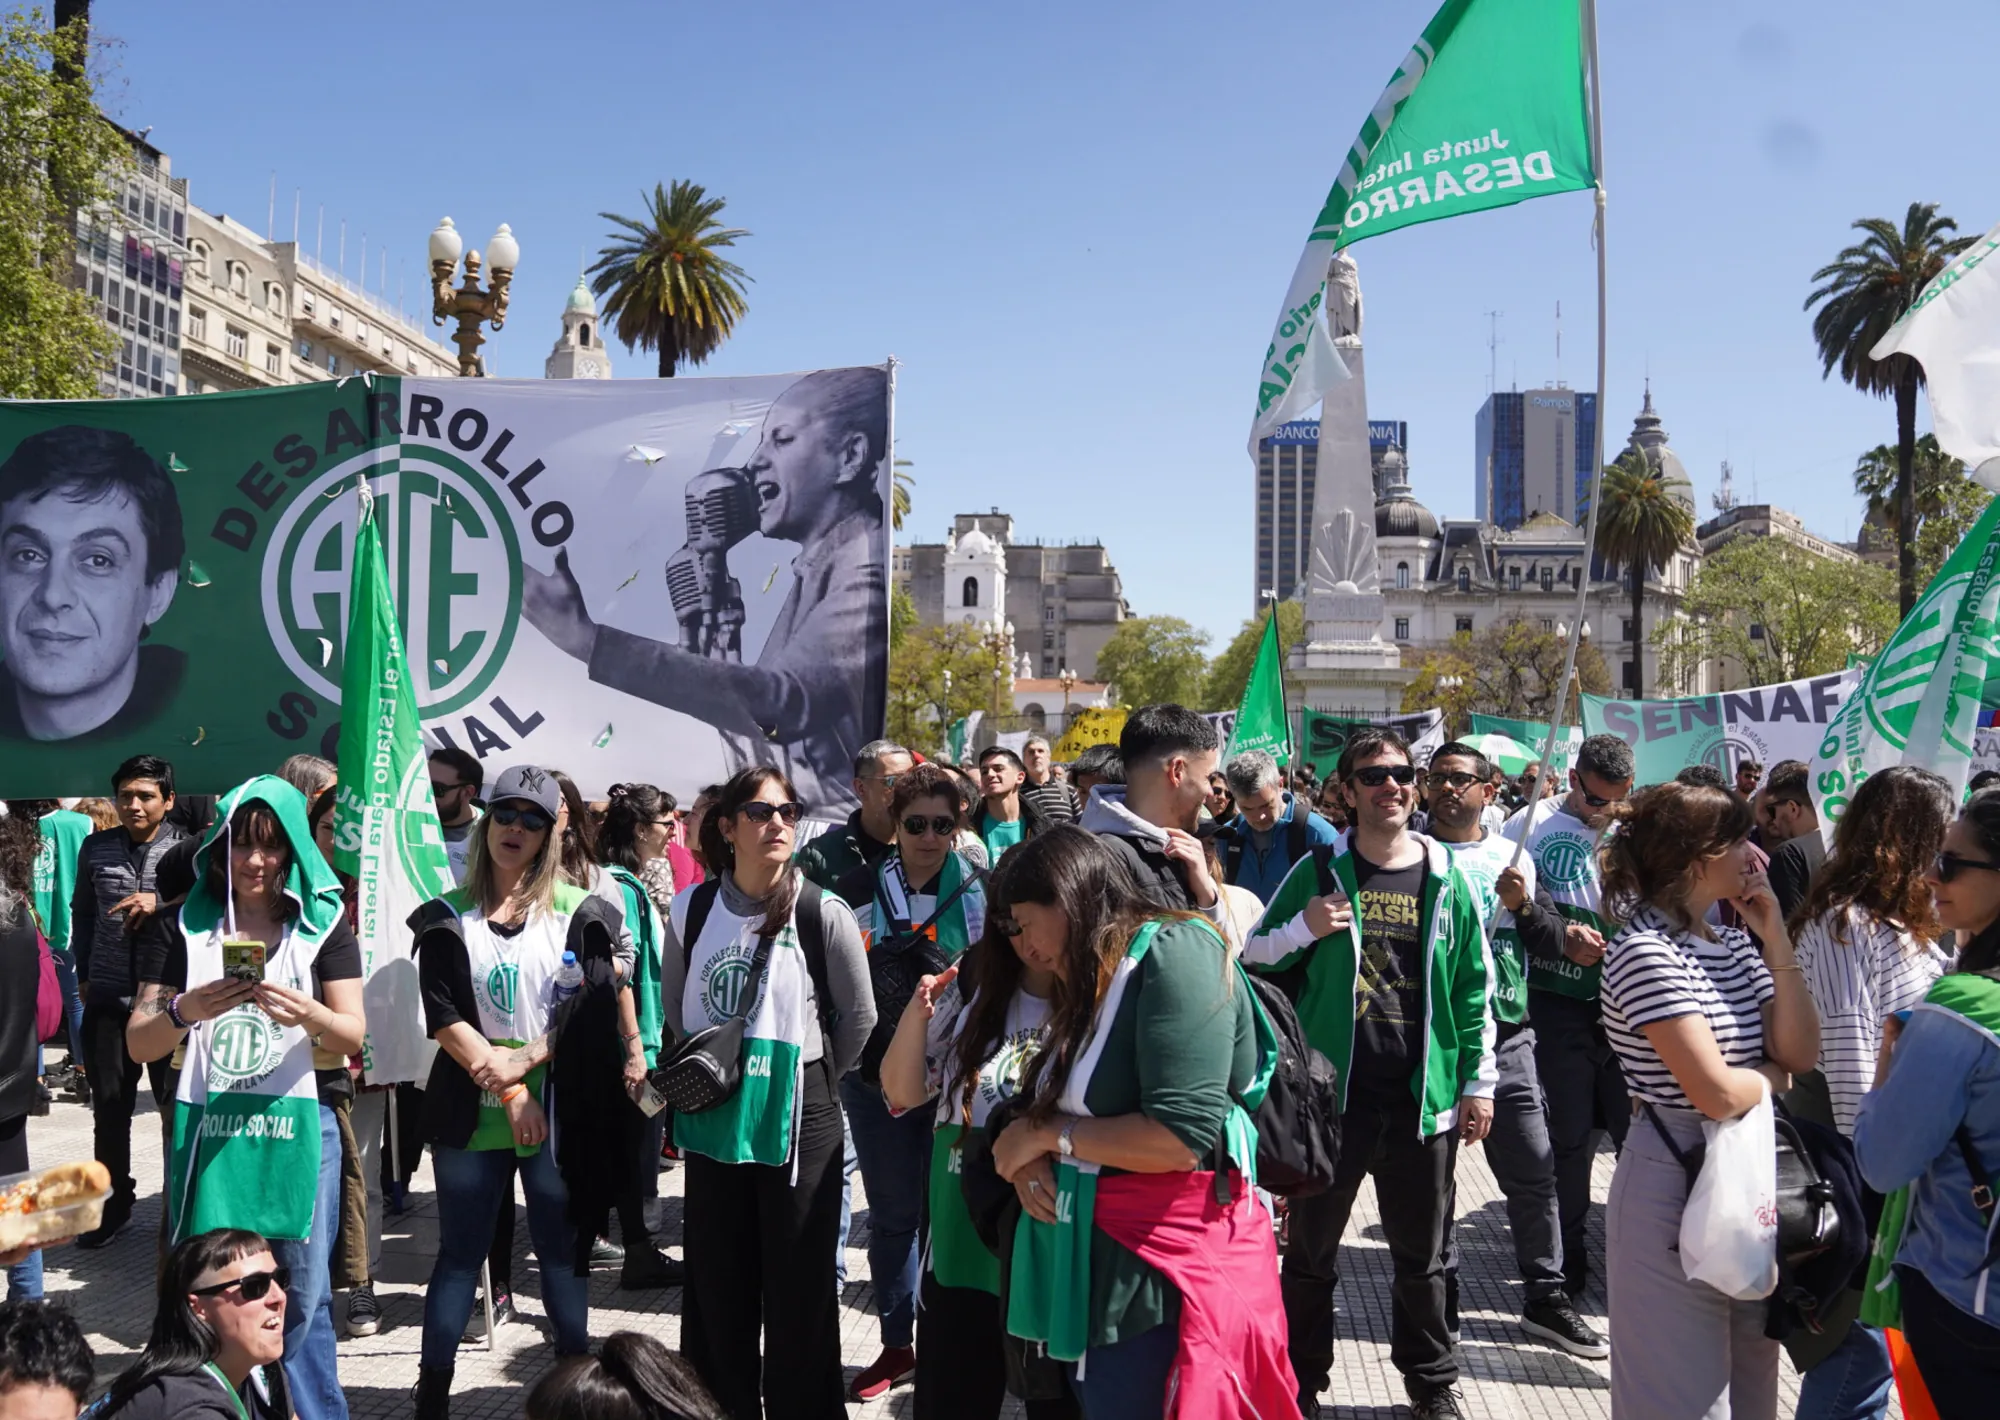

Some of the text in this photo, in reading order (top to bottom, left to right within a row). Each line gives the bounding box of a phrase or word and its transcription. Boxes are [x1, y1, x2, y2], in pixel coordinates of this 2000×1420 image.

[1533, 397, 1571, 409] Pampa
[1274, 426, 1395, 439] BANCO NIA
[211, 392, 574, 551] DESARROLLO
[1602, 675, 1841, 746] SENNAF
[1741, 725, 1768, 755] Estado
[519, 767, 546, 795] NY
[1546, 848, 1583, 878] ATE
[700, 946, 741, 982] FORTALECER
[491, 967, 518, 1010] AT
[713, 966, 749, 1015] AT
[213, 1021, 263, 1070] ATE
[244, 1079, 257, 1090] LA
[980, 1075, 997, 1104] PARA
[245, 1114, 295, 1140] SOCIAL
